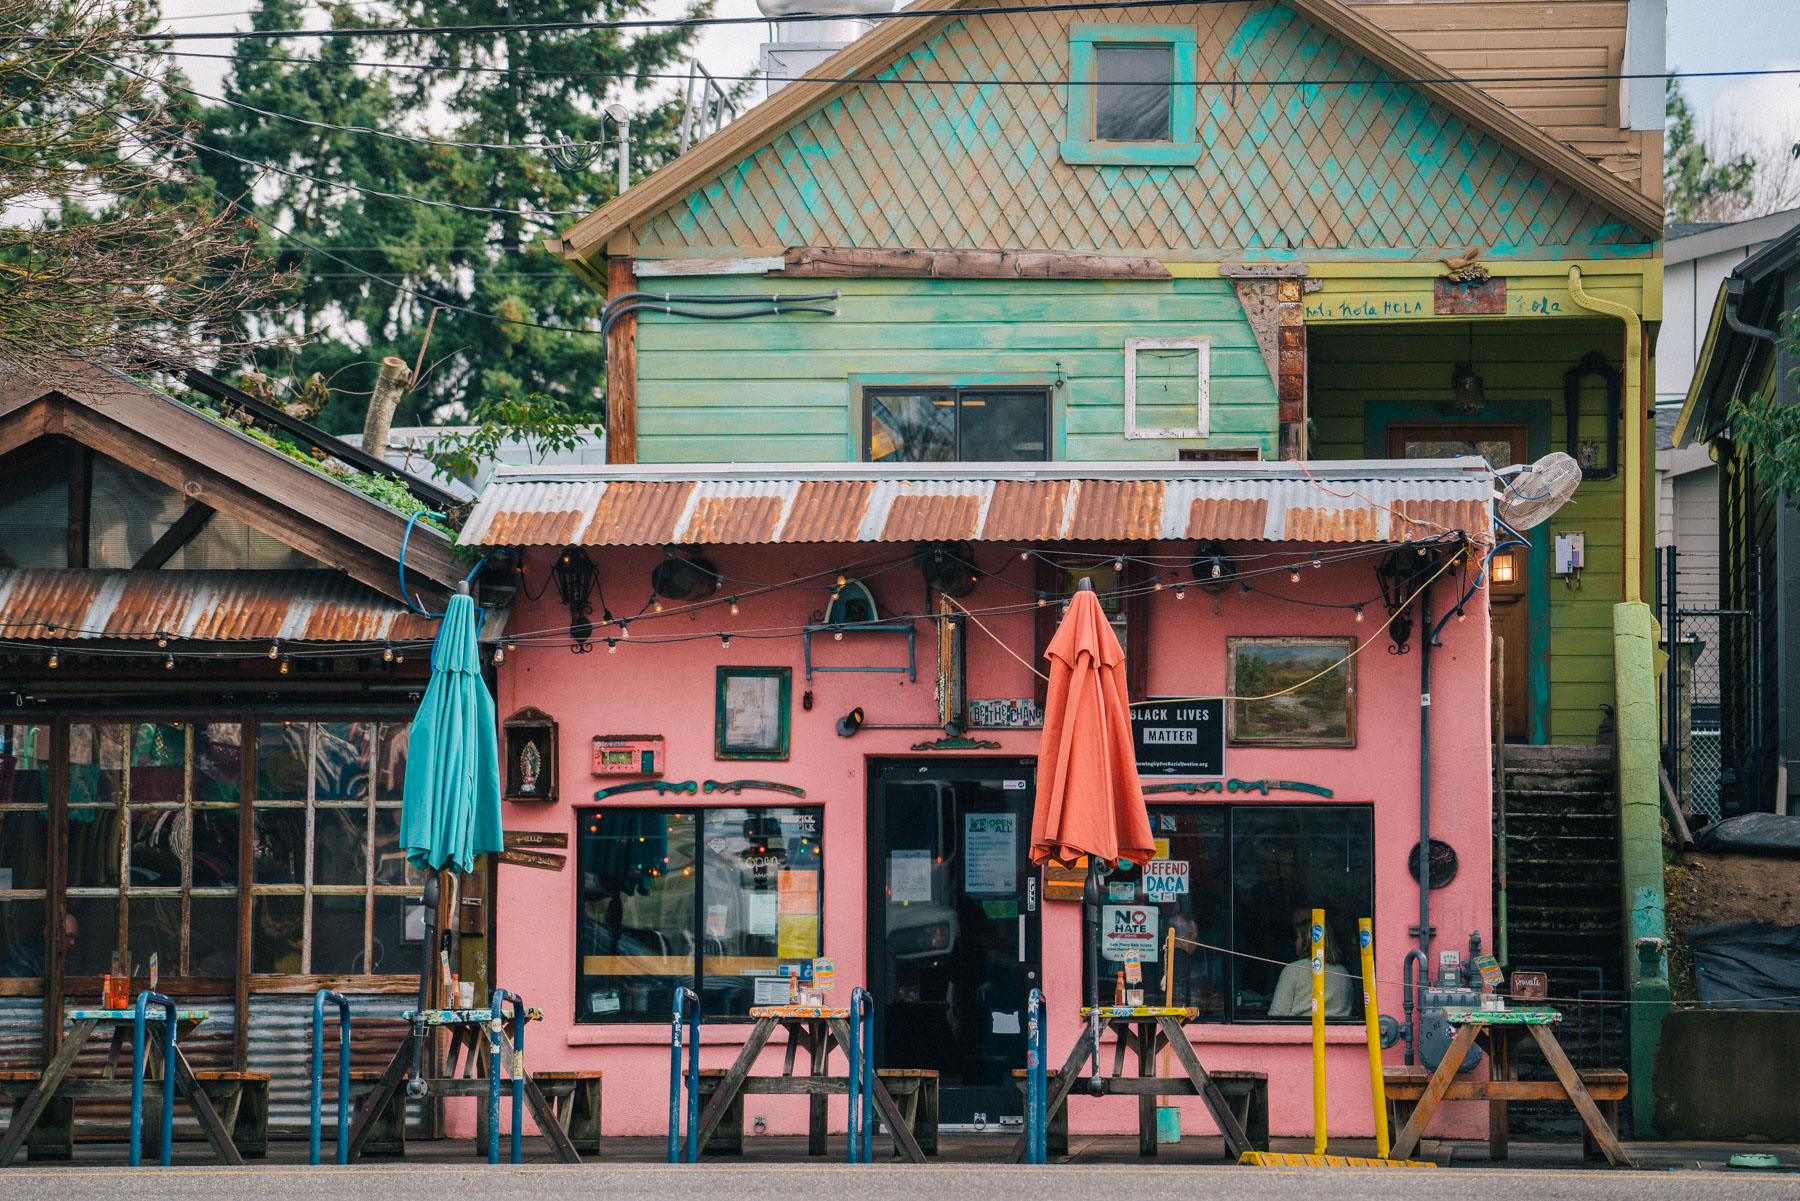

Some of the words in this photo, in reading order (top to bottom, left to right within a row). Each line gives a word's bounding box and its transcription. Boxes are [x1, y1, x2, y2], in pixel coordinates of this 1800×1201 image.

[1305, 302, 1333, 318] hola
[1339, 300, 1377, 317] hola
[1383, 300, 1422, 314] HOLA
[1130, 709, 1168, 721] BLACK
[1176, 709, 1209, 721] LIVES
[1148, 730, 1194, 742] MATTER
[989, 818, 1013, 827] OPEN
[995, 825, 1013, 834] ALL
[1143, 862, 1188, 876] DEFEND
[1147, 876, 1185, 893] DACA
[1115, 910, 1147, 925] NO
[1115, 924, 1147, 933] HATE
[1514, 976, 1540, 990] private
